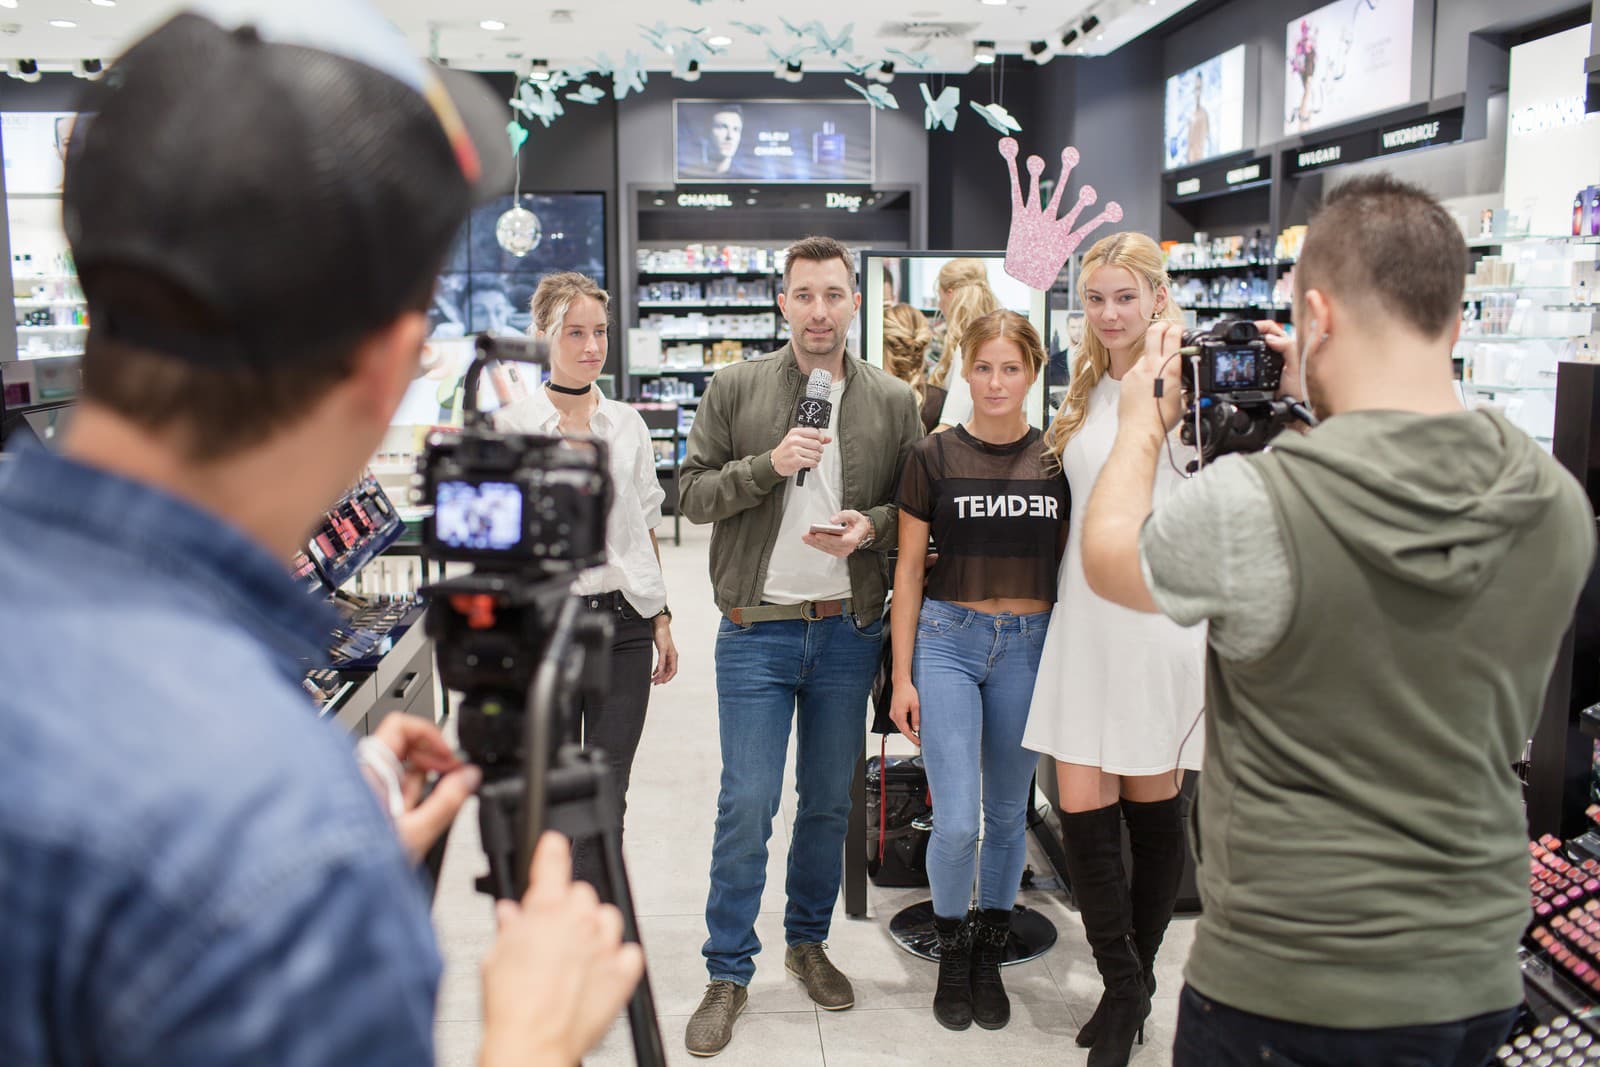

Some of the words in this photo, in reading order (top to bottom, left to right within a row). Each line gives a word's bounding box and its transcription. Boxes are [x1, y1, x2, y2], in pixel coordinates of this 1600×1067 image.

[1298, 145, 1341, 167] BVLGARI
[677, 193, 733, 207] CHANEL
[825, 192, 862, 209] Dior
[953, 494, 1058, 520] TENDER
